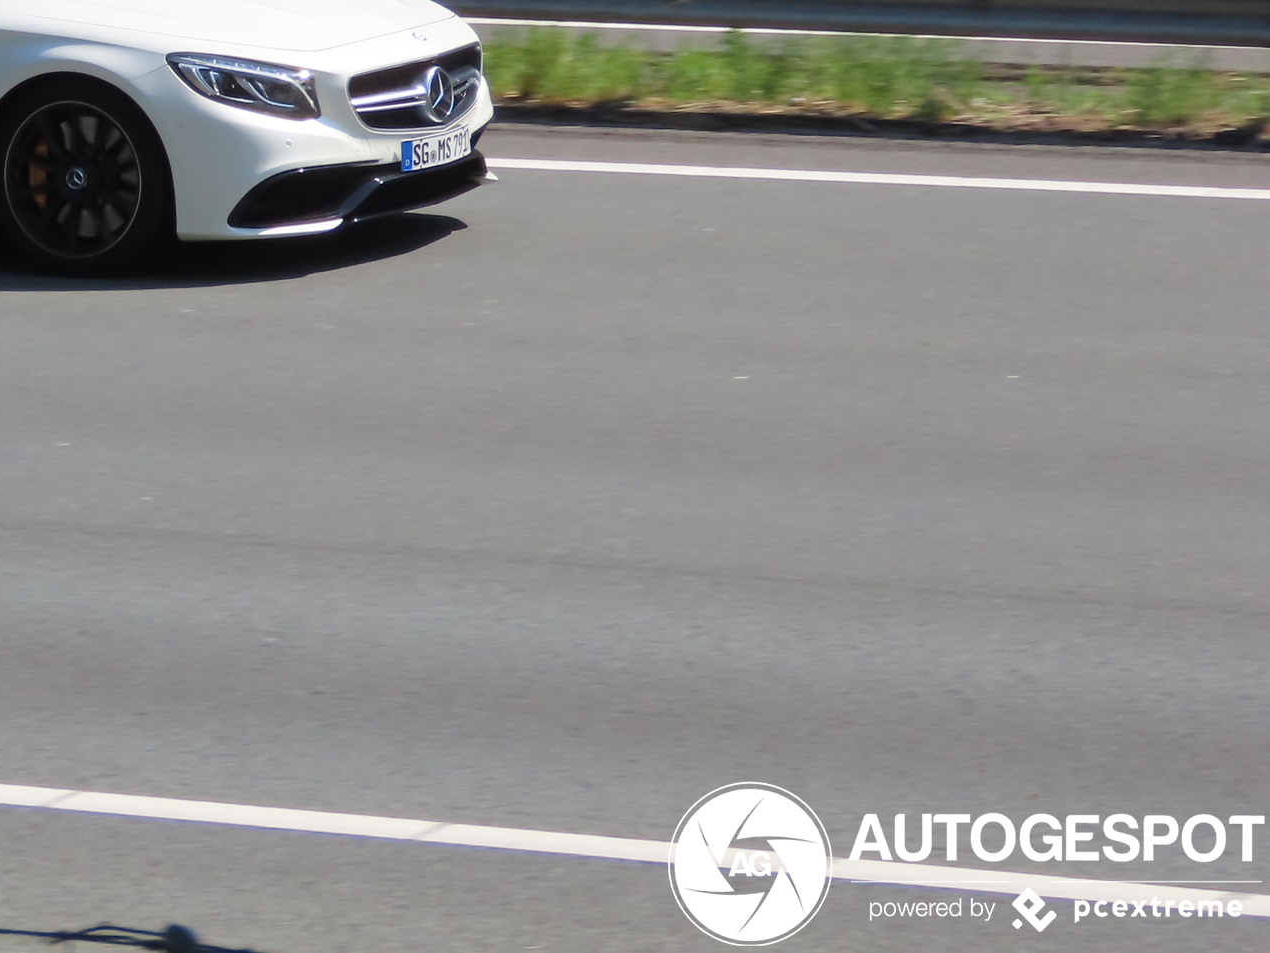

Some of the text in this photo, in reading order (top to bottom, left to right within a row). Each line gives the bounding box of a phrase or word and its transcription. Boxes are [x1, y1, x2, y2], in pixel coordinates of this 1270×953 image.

[413, 142, 429, 166] SG
[438, 137, 451, 162] MS
[405, 159, 410, 167] D
